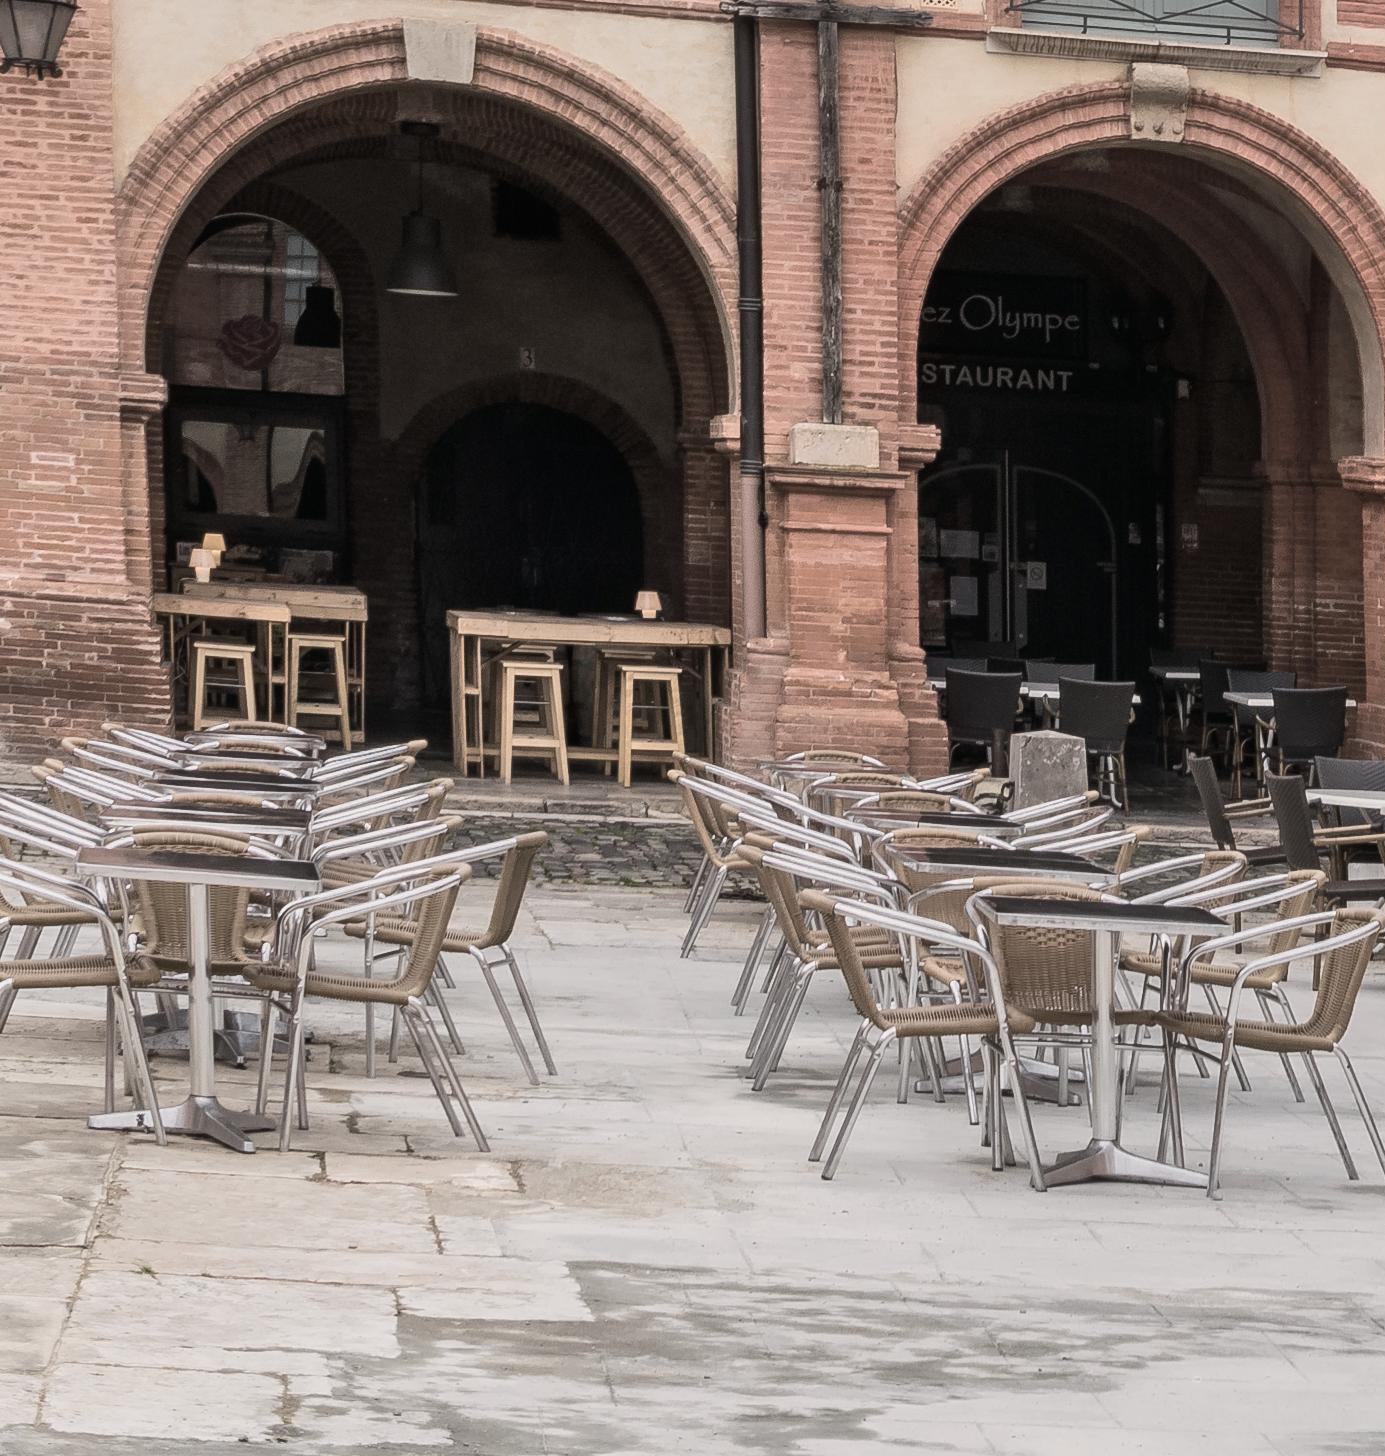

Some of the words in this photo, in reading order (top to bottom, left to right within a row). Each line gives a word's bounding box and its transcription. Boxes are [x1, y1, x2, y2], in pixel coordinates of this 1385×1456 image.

[922, 306, 952, 323] ez
[960, 294, 1080, 343] Olympe
[522, 348, 533, 368] 3
[922, 363, 1073, 391] STAURANT
